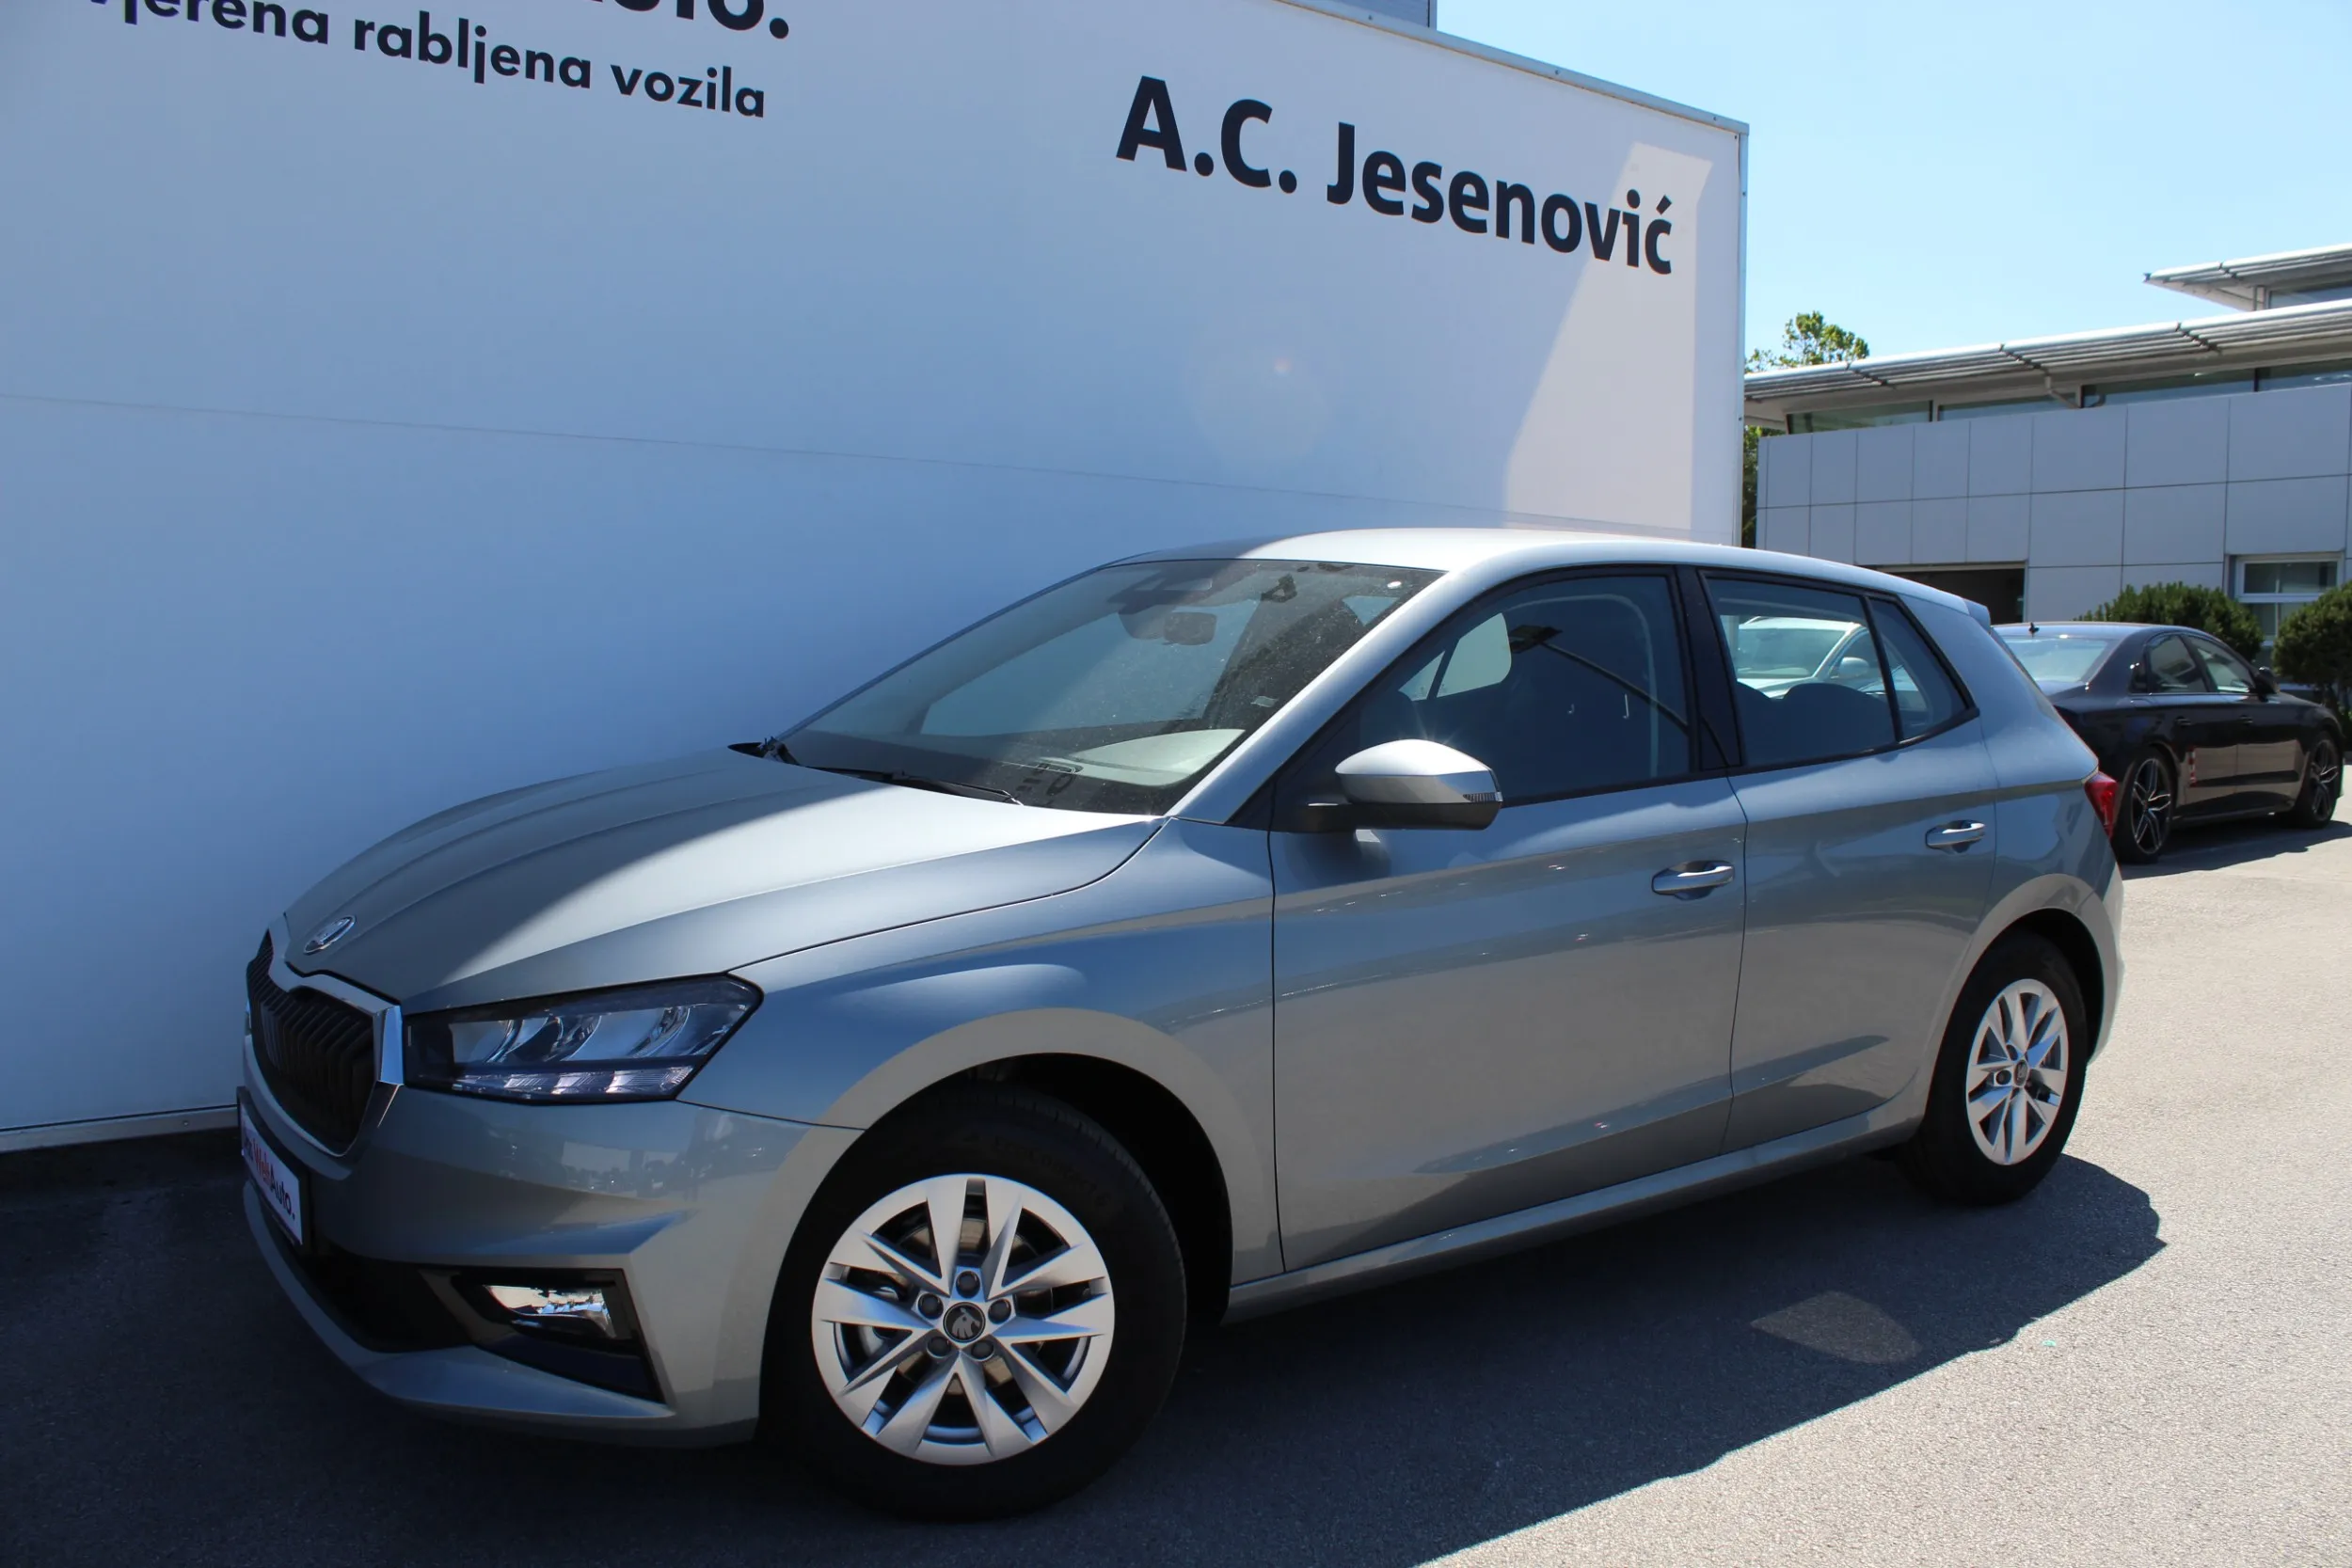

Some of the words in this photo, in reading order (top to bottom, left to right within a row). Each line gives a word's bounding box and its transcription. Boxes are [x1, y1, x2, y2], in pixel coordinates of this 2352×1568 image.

[355, 10, 592, 88] rabljena
[611, 65, 765, 118] vozila
[1116, 75, 1297, 194] A.C.
[1327, 122, 1672, 275] Jesenović
